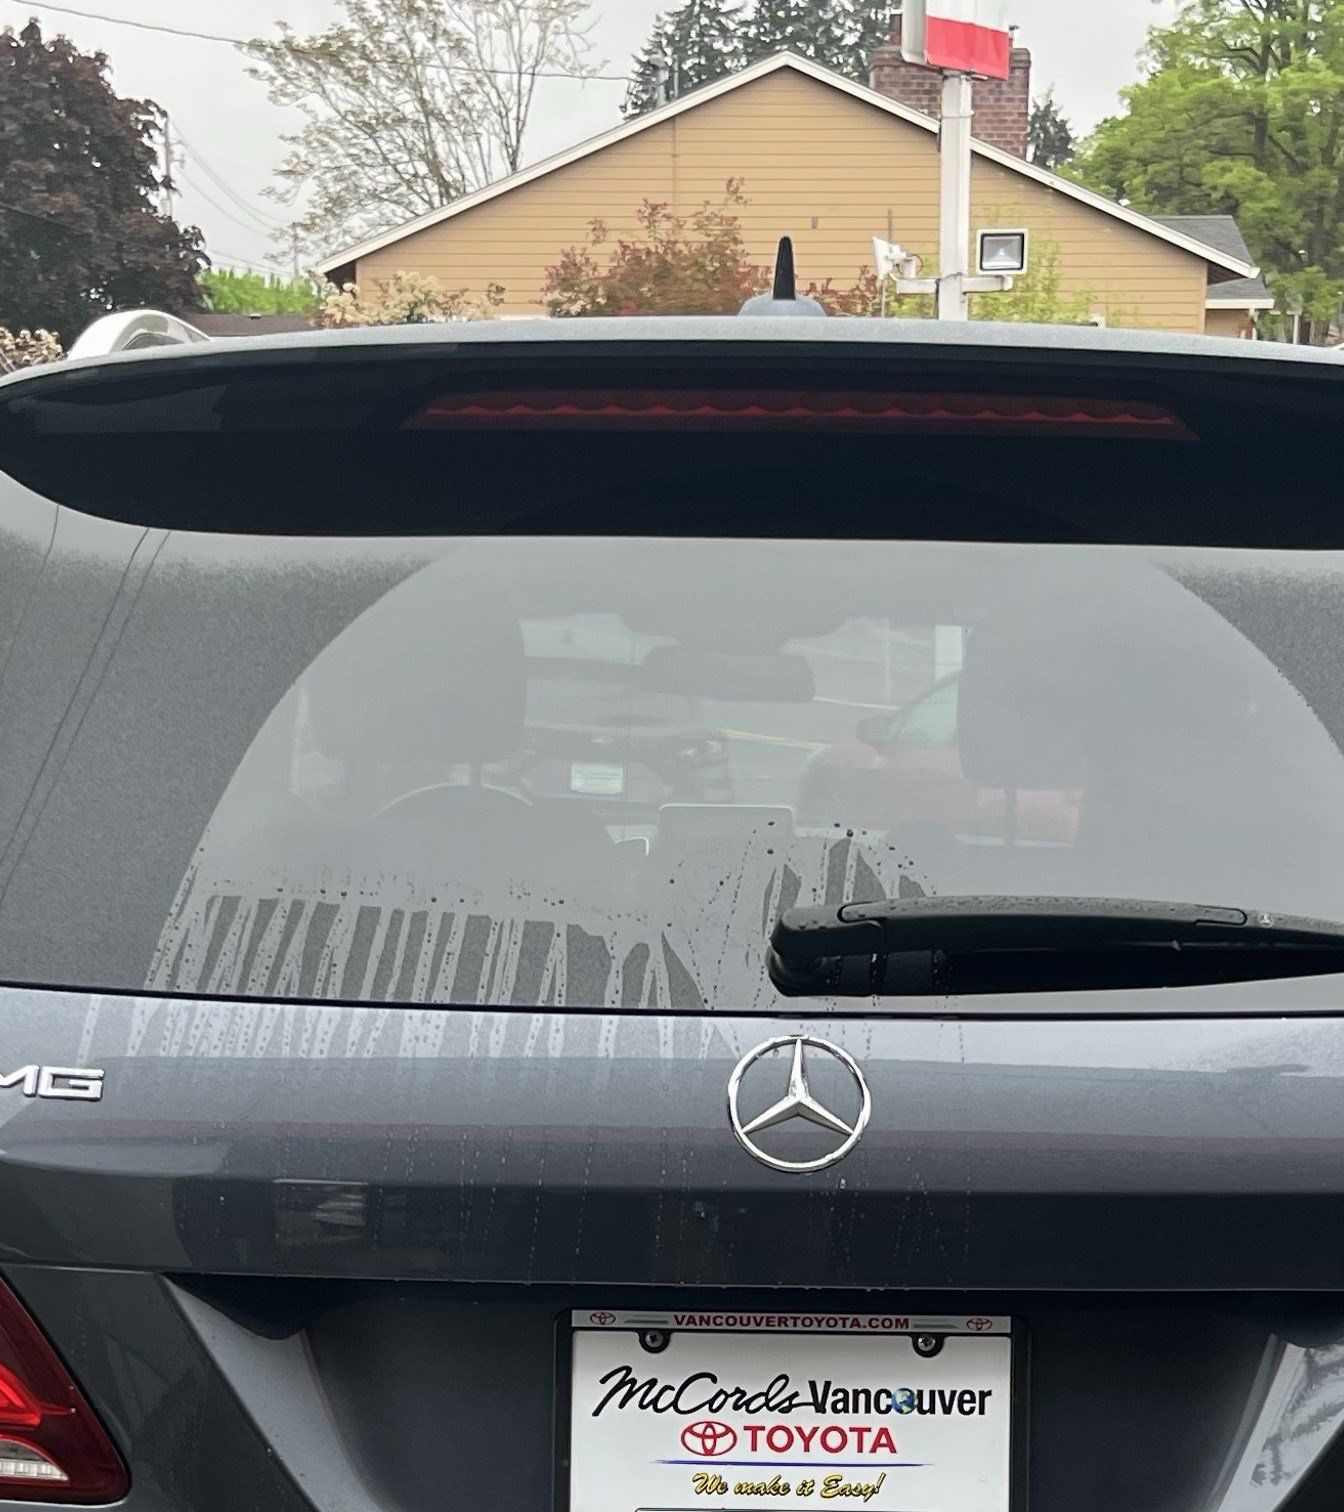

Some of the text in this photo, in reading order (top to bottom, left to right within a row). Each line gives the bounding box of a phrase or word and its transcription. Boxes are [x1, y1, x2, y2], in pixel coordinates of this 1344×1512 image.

[673, 1313, 911, 1331] VANCOUVERTOYOTA.COM
[592, 1365, 993, 1417] McCords Vancouver
[742, 1424, 898, 1455] TOYOTA
[692, 1472, 887, 1503] We make it Easy!
